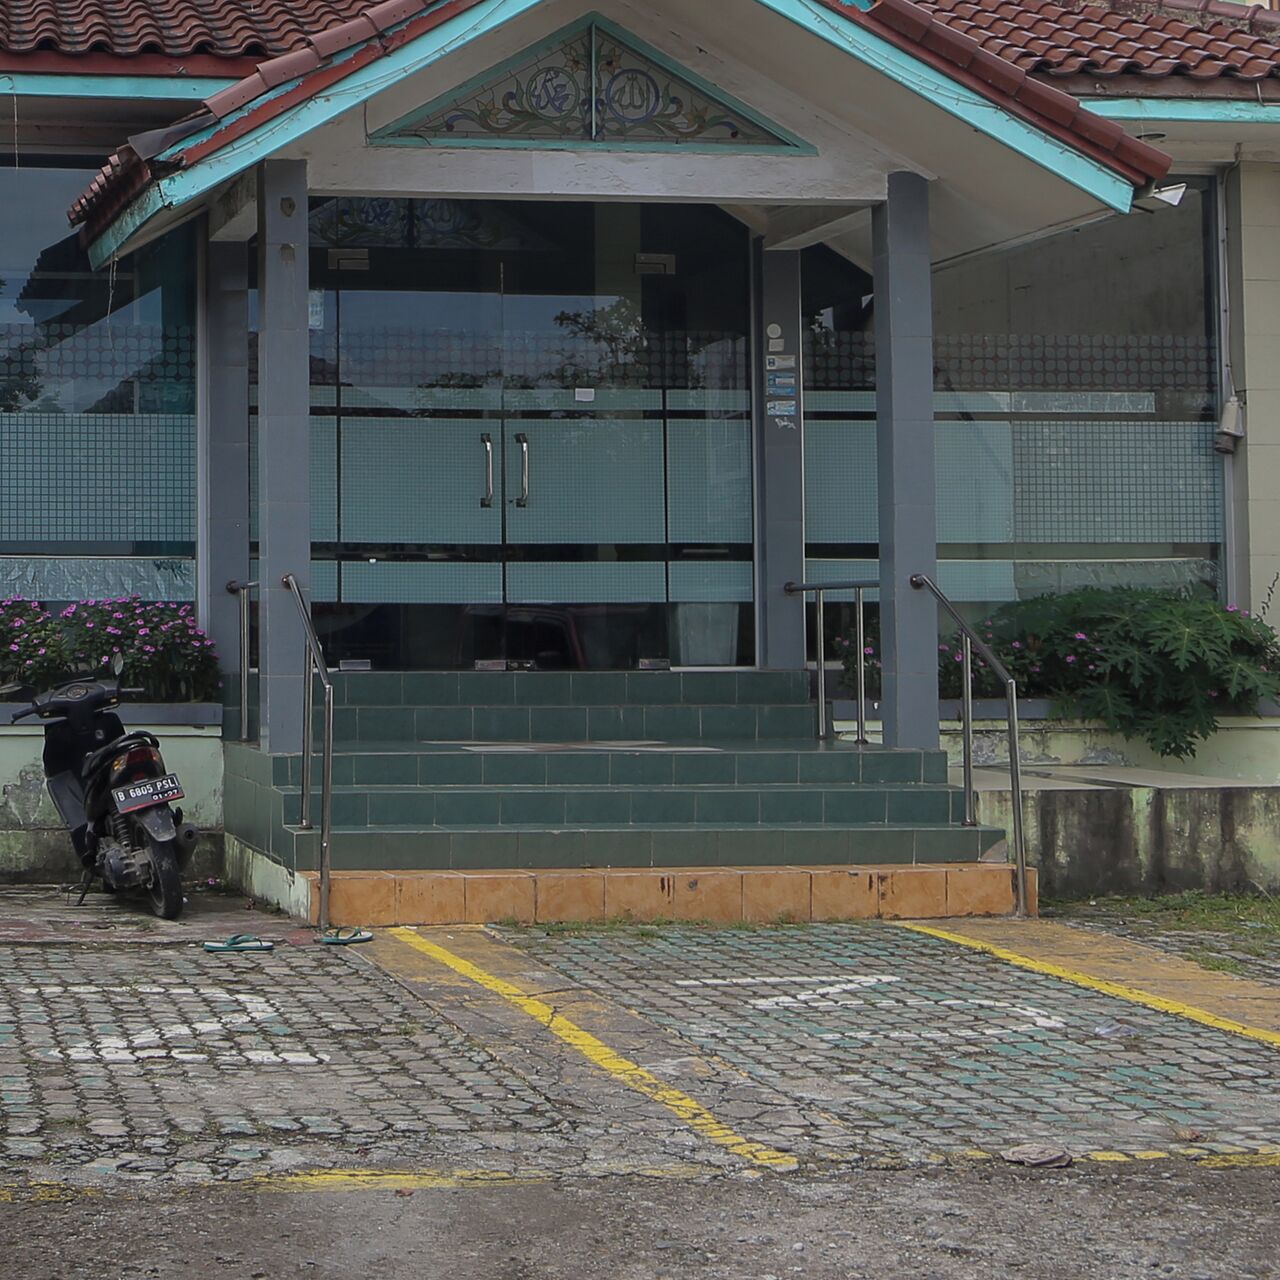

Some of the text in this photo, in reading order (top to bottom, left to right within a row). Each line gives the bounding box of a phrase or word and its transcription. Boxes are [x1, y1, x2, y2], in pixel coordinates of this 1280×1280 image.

[117, 778, 175, 801] B 6805 PSL
